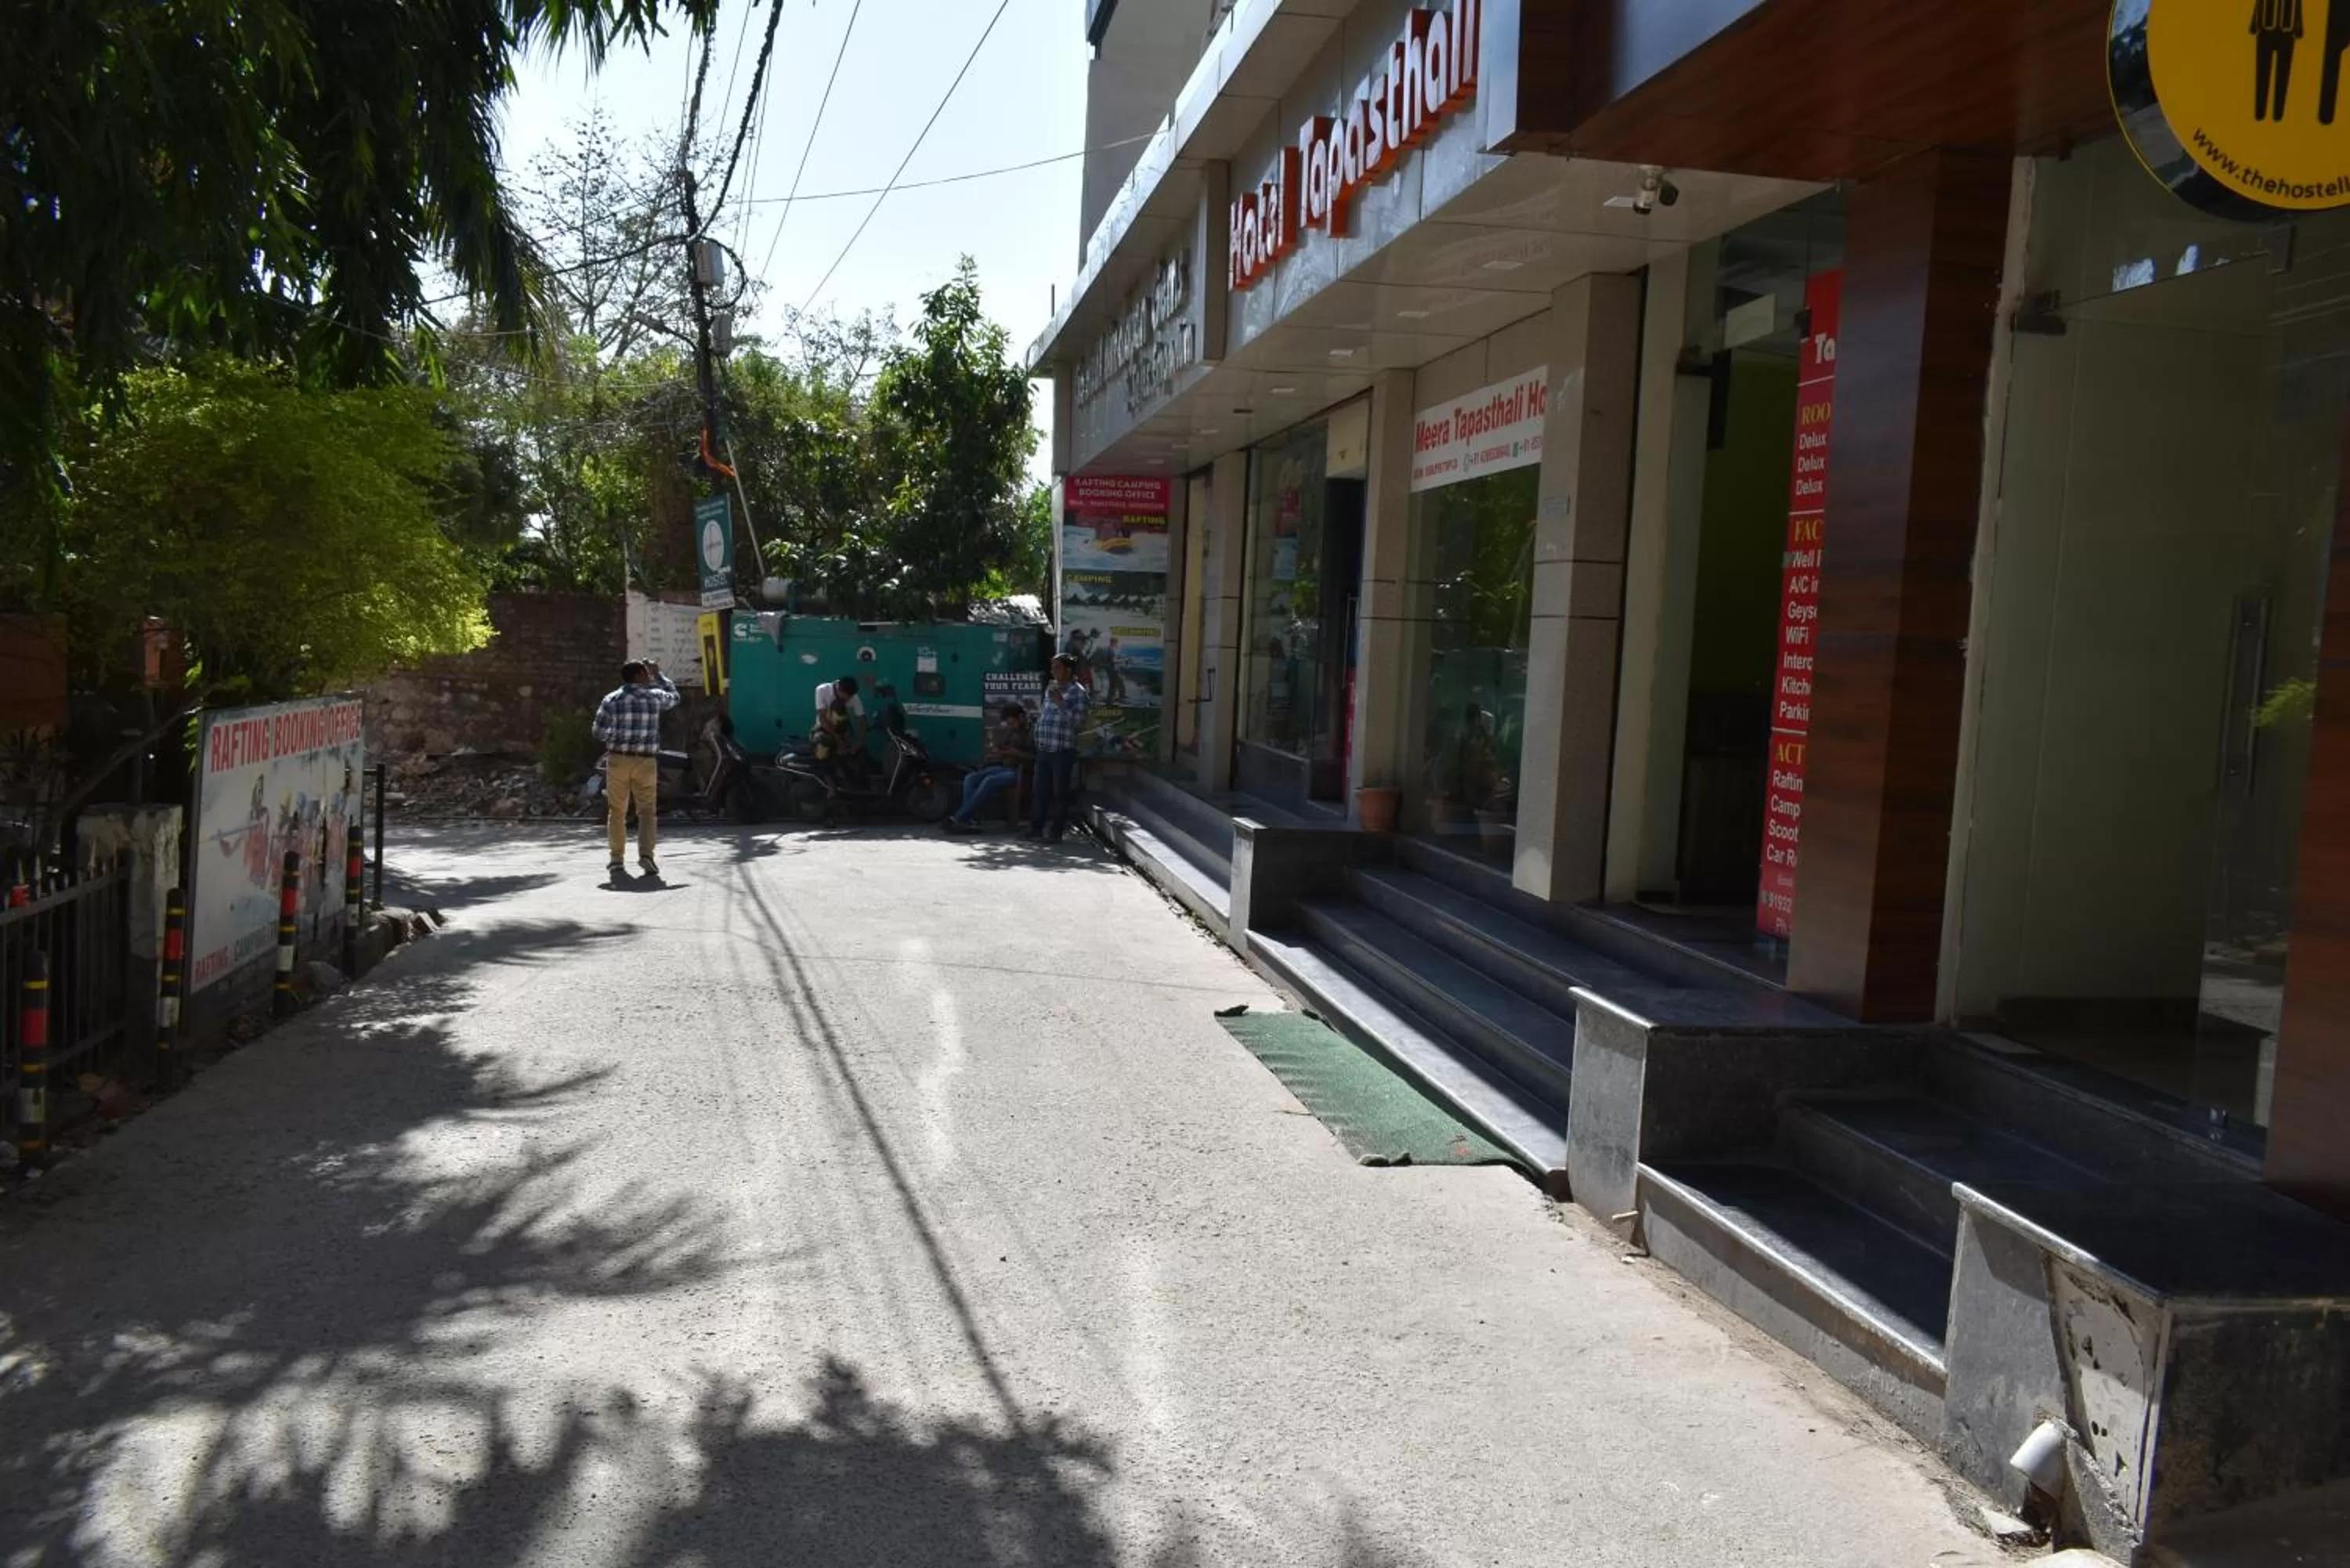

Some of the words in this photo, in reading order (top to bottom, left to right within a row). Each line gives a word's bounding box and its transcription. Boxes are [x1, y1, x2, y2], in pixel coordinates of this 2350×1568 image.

[1228, 147, 1291, 292] Hotel
[1415, 418, 1450, 453] Meera
[1454, 384, 1524, 446] Tapasthali
[212, 718, 270, 772] RAFTING
[274, 708, 324, 757] BOOKING
